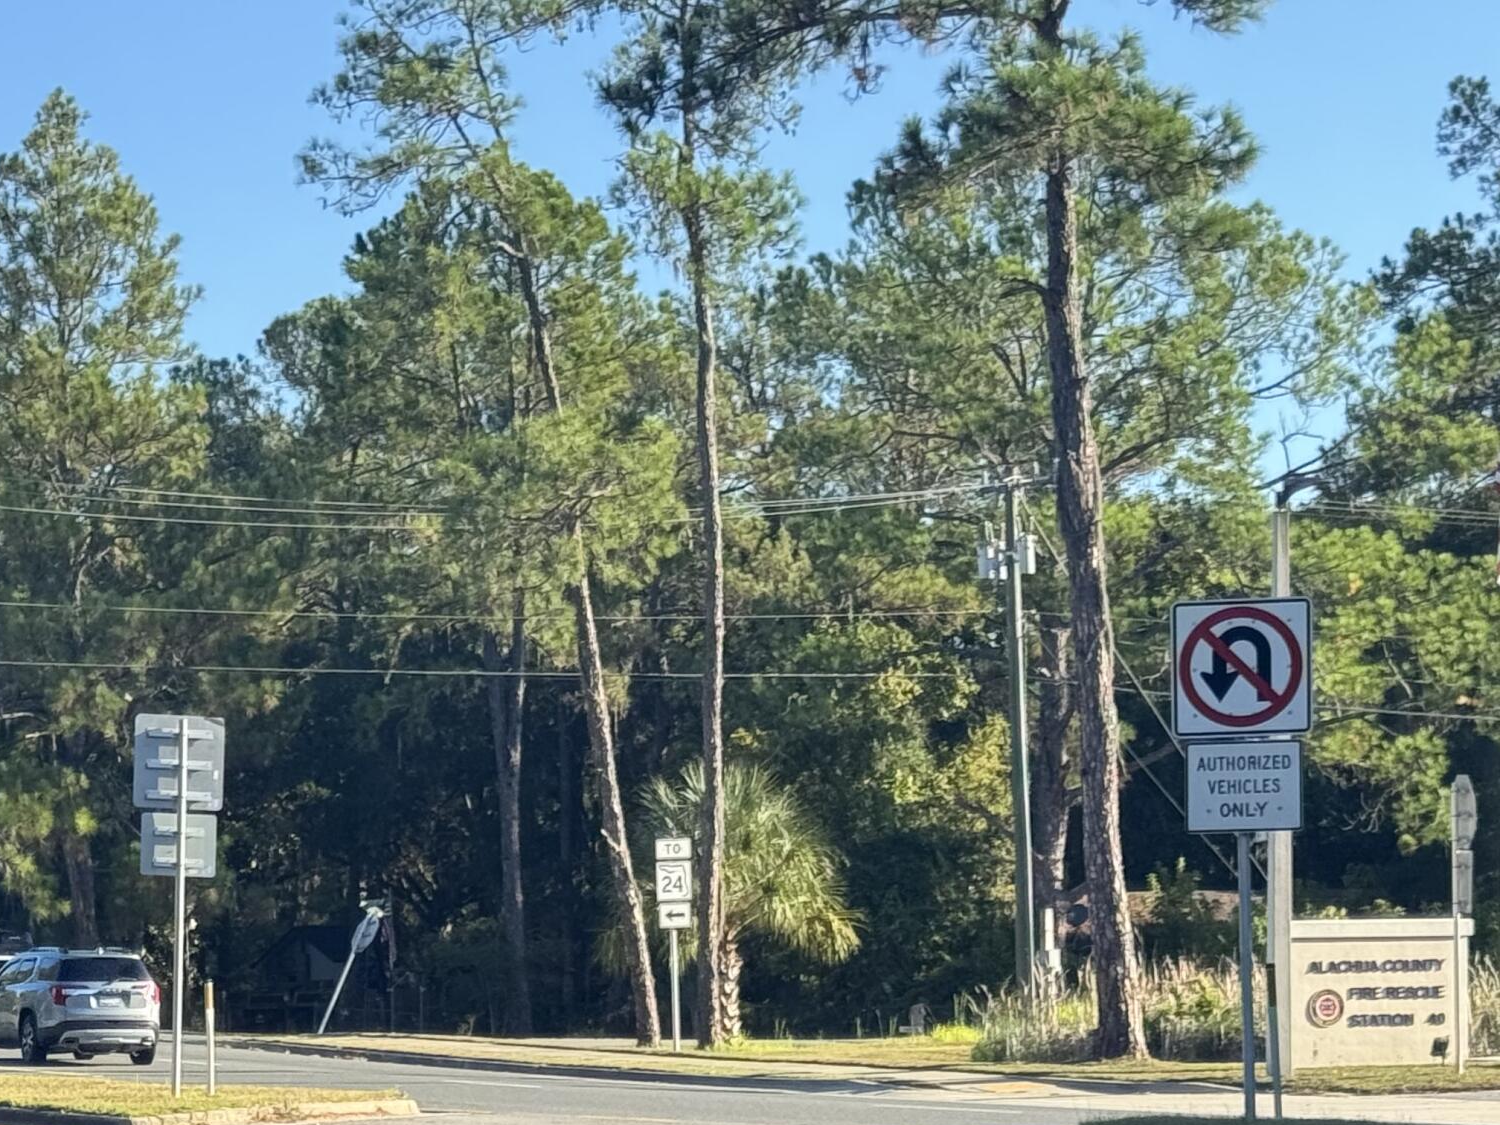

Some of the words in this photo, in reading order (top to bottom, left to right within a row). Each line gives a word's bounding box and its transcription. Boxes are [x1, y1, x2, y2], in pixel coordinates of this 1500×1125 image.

[1196, 755, 1291, 772] AUTHORIZED
[1208, 778, 1281, 795] VEHICLES
[1219, 801, 1268, 818] ONLY
[664, 843, 681, 855] TO
[662, 875, 683, 894] 24
[1307, 960, 1379, 974] ALACHUA
[1381, 958, 1445, 973] COUNTY
[1347, 986, 1381, 1000] FIRE
[1384, 985, 1445, 1000] RESCUE
[1347, 1013, 1414, 1028] STATION
